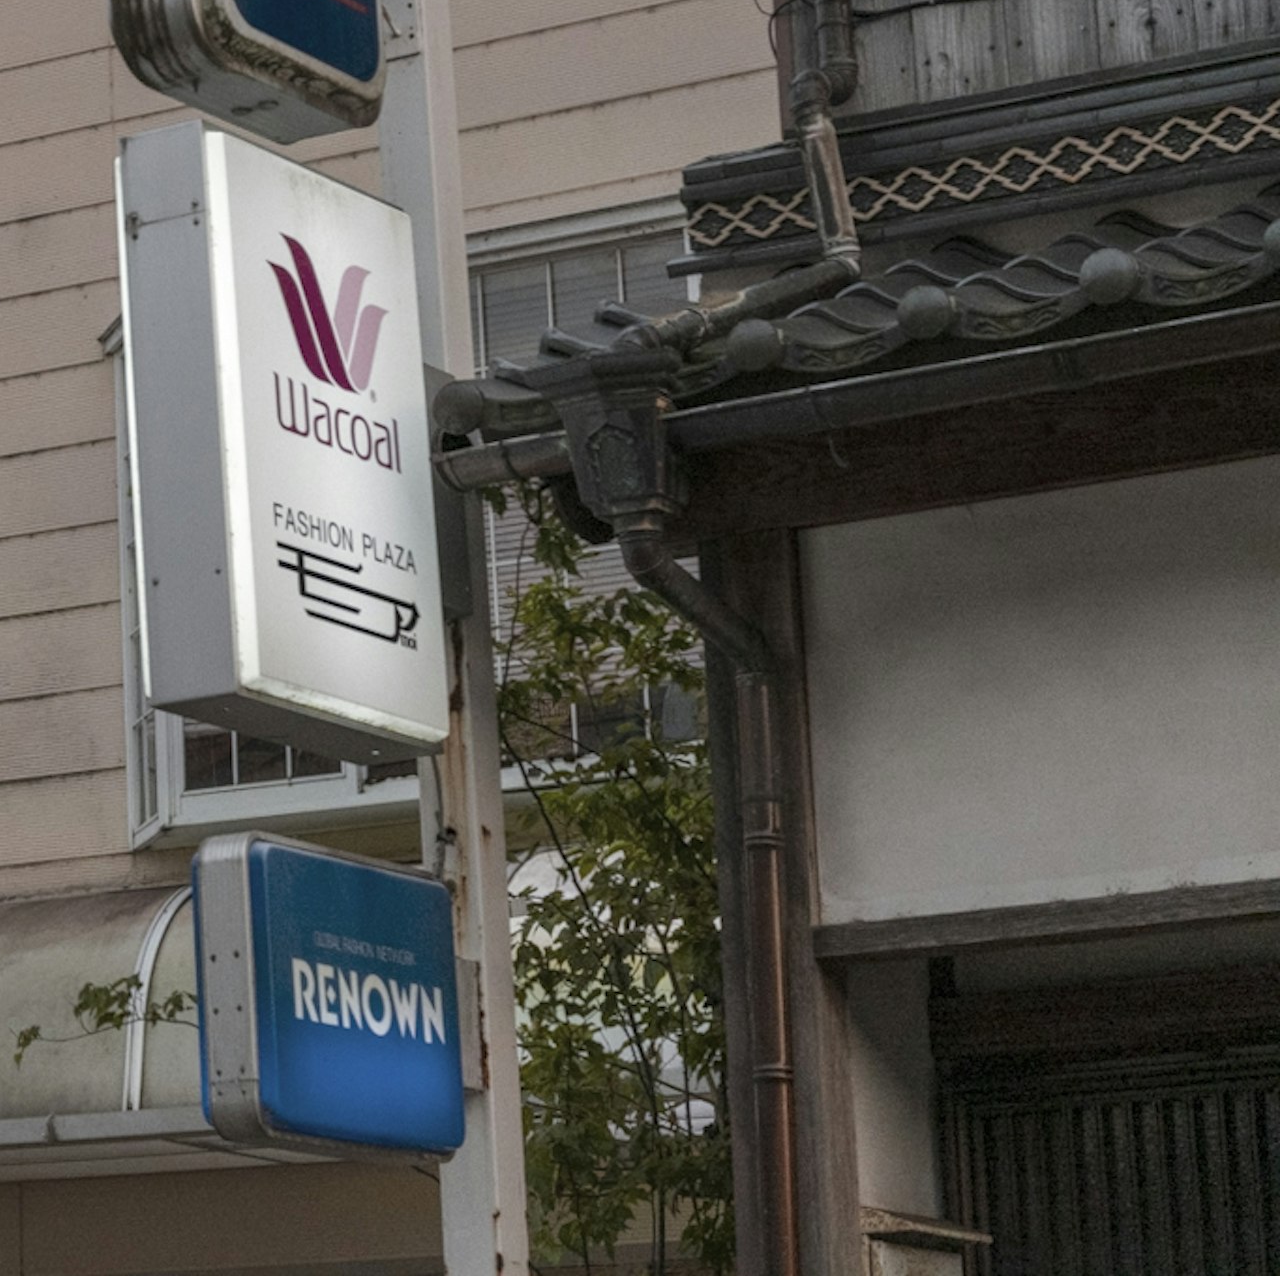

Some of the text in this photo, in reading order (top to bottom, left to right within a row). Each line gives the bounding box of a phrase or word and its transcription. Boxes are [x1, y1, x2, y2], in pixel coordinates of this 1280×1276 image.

[273, 371, 402, 474] Wacoal
[272, 502, 417, 575] FASHION PLAZA
[292, 957, 446, 1045] RENOWN
